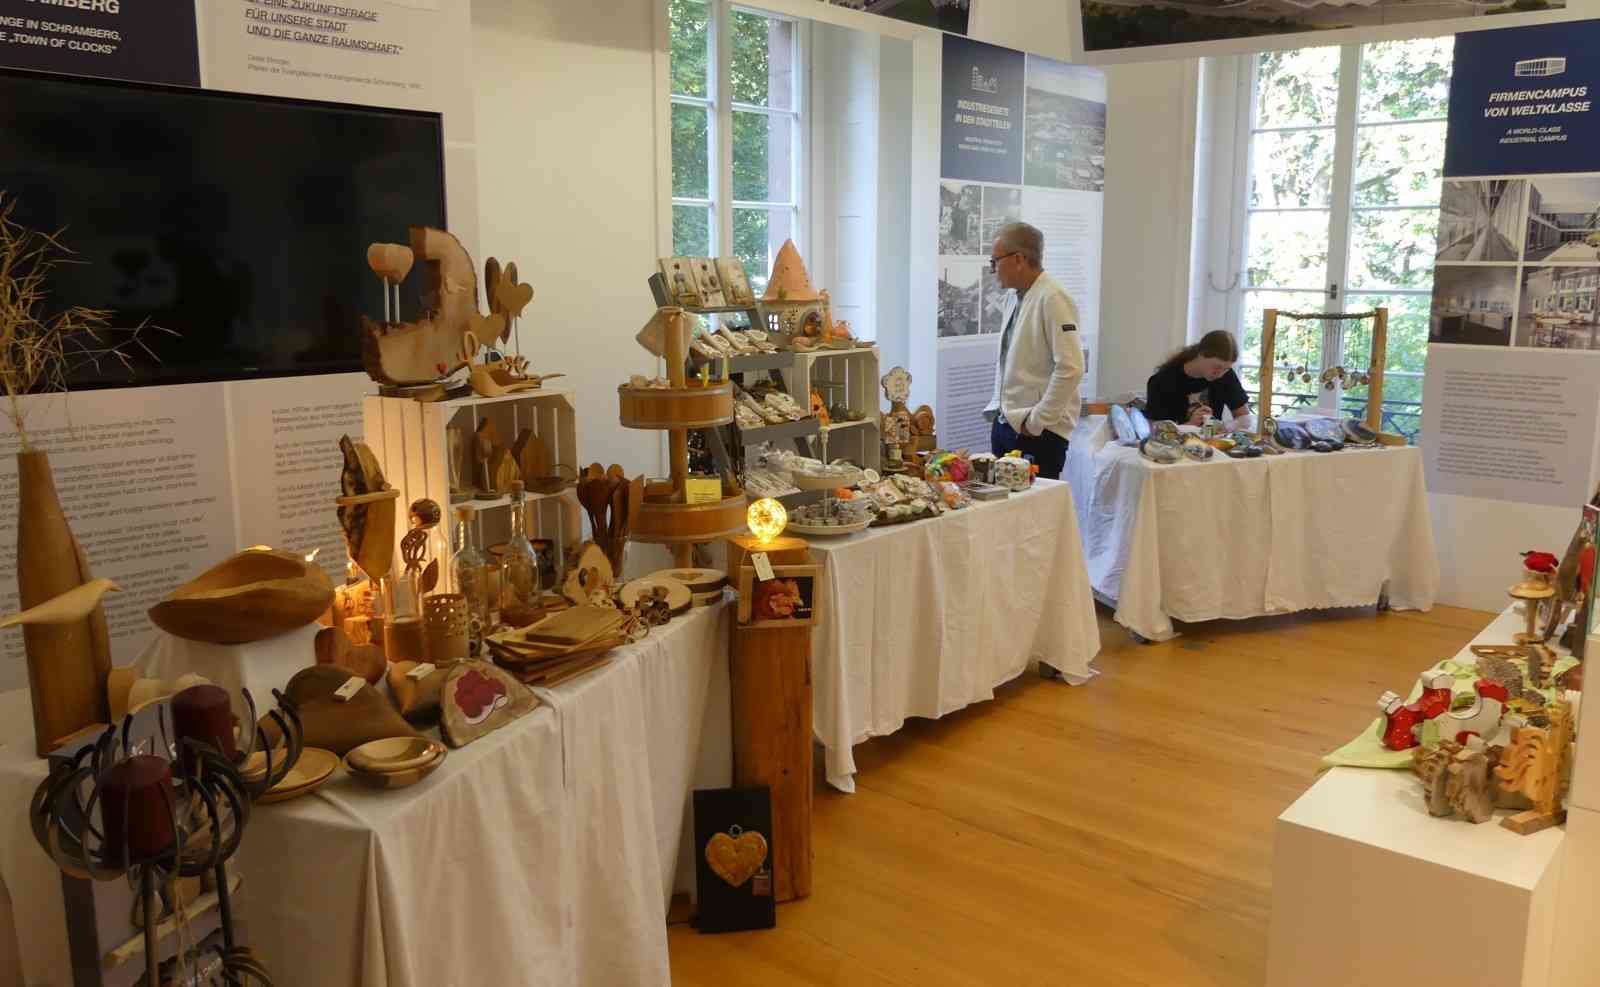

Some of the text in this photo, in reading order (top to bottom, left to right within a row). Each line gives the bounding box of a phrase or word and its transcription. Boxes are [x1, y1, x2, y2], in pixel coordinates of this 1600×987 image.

[26, 19, 39, 30] IN
[245, 8, 347, 32] FÜR UNSERE STADT
[50, 38, 66, 48] OF
[246, 25, 271, 37] UND
[274, 28, 292, 40] DIE
[294, 31, 329, 45] GANZE
[1489, 86, 1588, 102] FIRMENCAMPUS
[1484, 101, 1592, 118] VON WELTKLASSE
